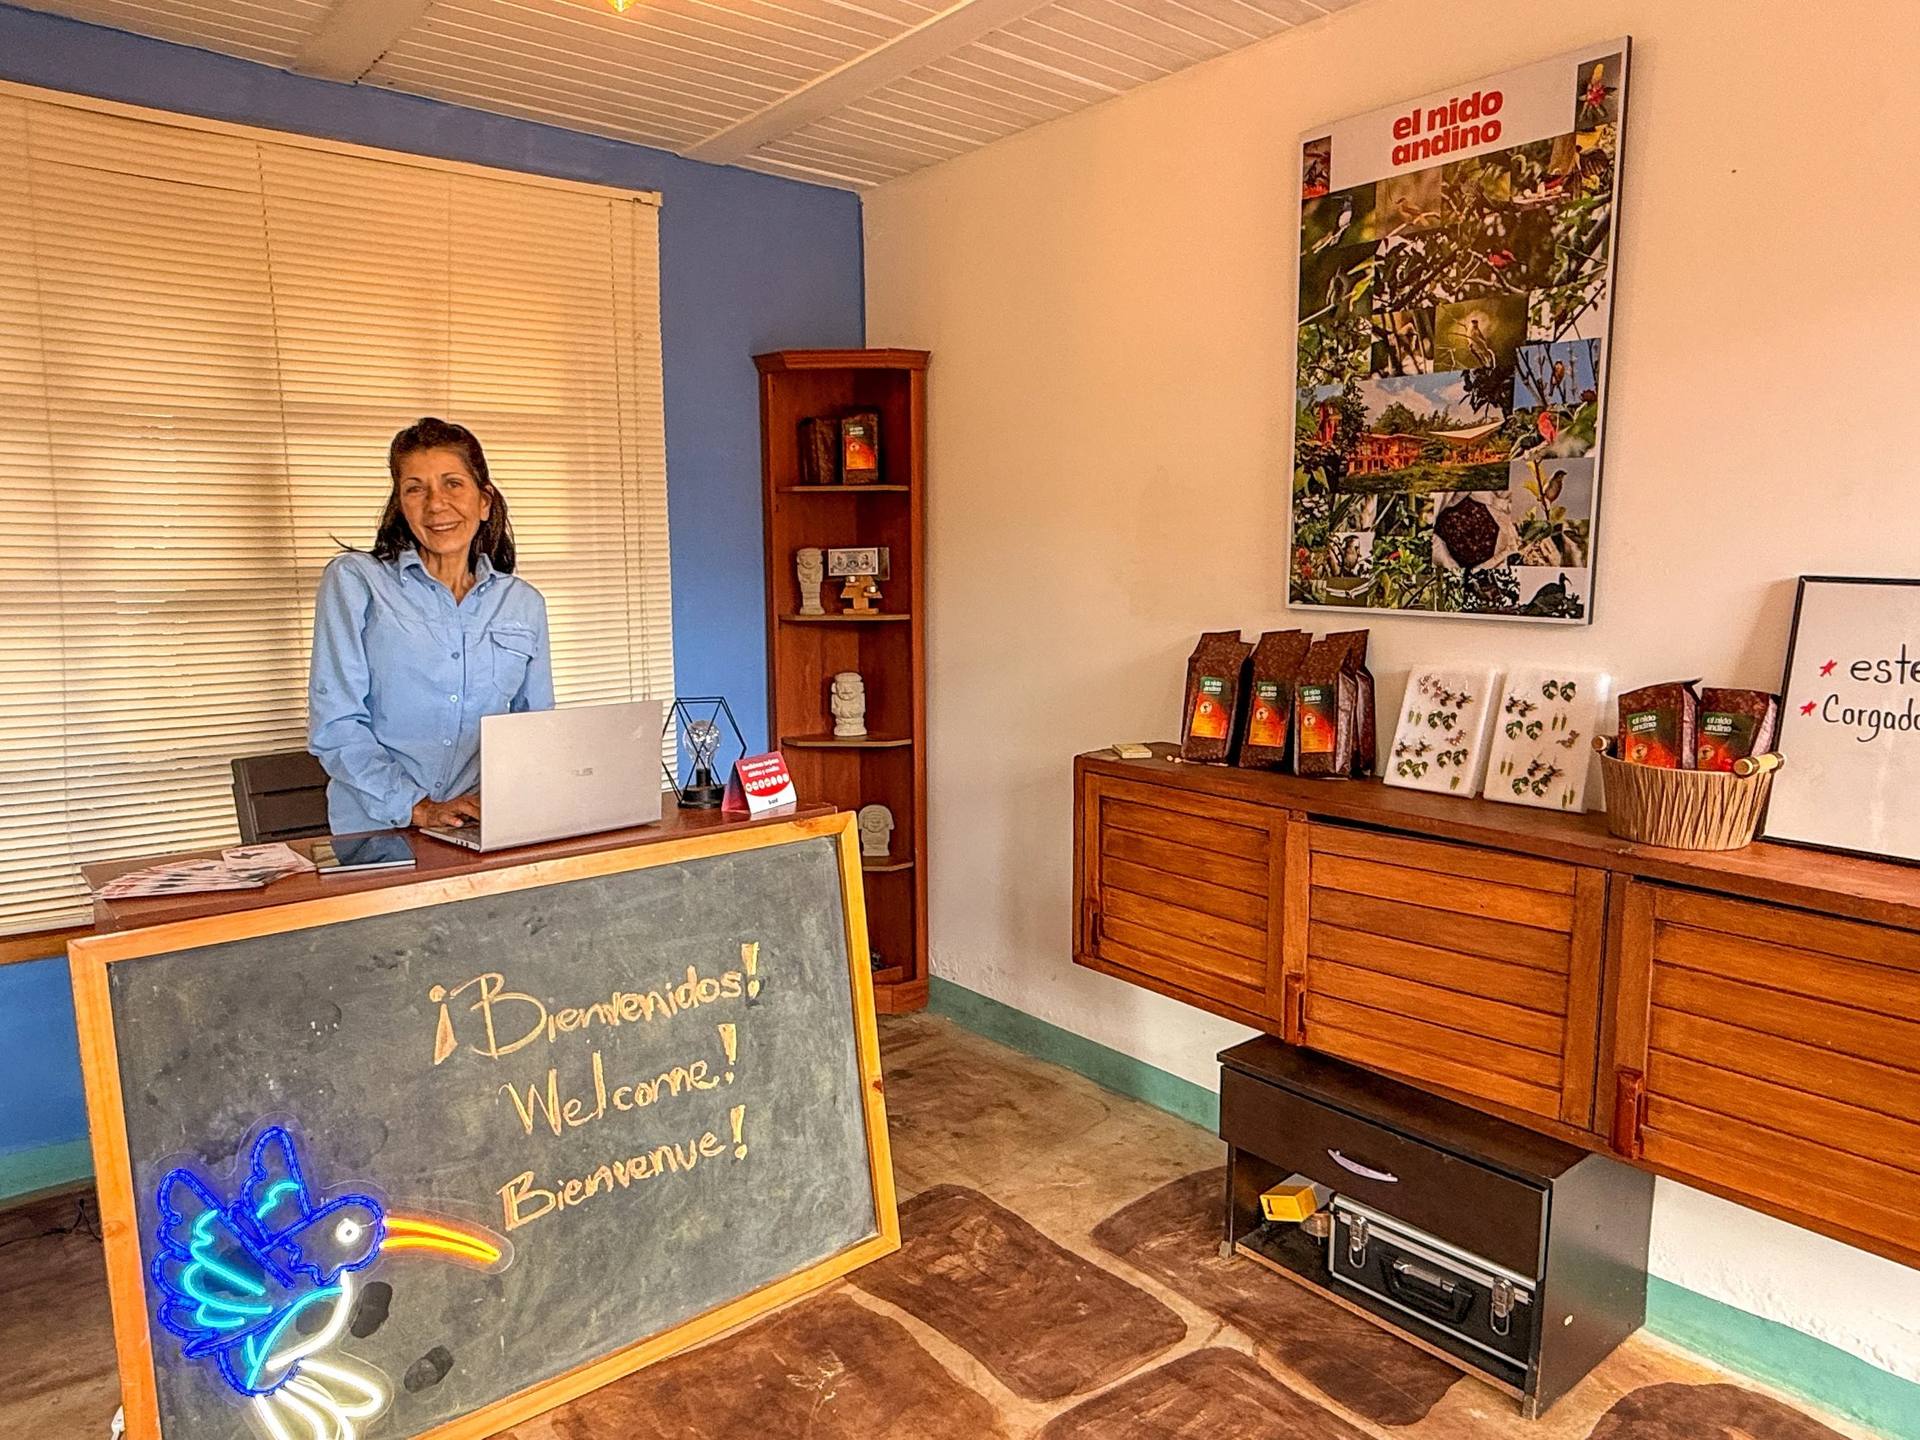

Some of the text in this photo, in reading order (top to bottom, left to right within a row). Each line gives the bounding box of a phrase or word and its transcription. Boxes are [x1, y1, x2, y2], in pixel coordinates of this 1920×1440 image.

[1392, 91, 1503, 140] el nido
[1392, 119, 1502, 166] andino
[1632, 721, 1657, 732] andino
[1639, 715, 1656, 723] nido
[1705, 724, 1732, 732] andino
[1714, 717, 1732, 725] nido
[497, 1024, 738, 1136] Welcome!
[496, 1104, 748, 1231] Bienvenue!
